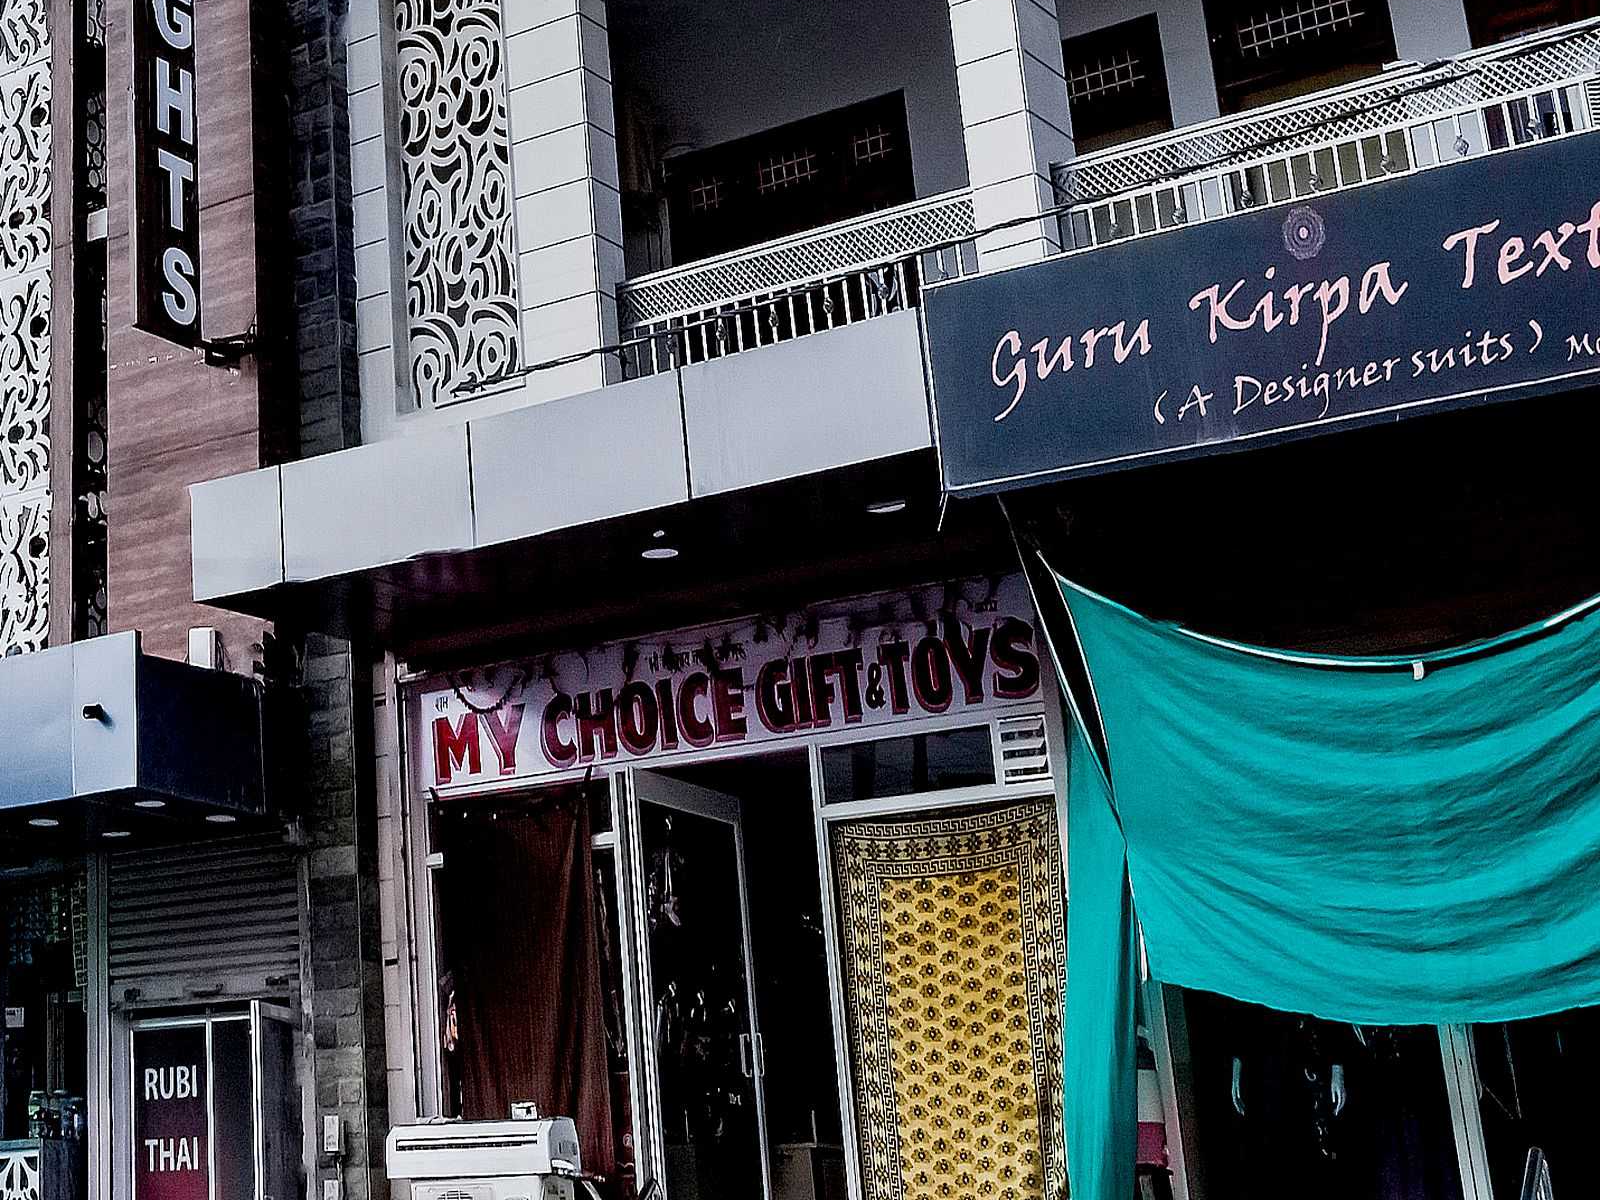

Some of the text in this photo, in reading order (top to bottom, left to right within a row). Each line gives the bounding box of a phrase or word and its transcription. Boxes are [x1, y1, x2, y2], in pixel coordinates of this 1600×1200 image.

[991, 318, 1152, 423] Guru
[1187, 266, 1408, 366] Kirpa
[1232, 356, 1402, 421] Designer
[431, 618, 1043, 786] MY CHOICE GIFT & TOYS
[144, 1064, 198, 1101] RUBI
[144, 1136, 199, 1172] THAI
